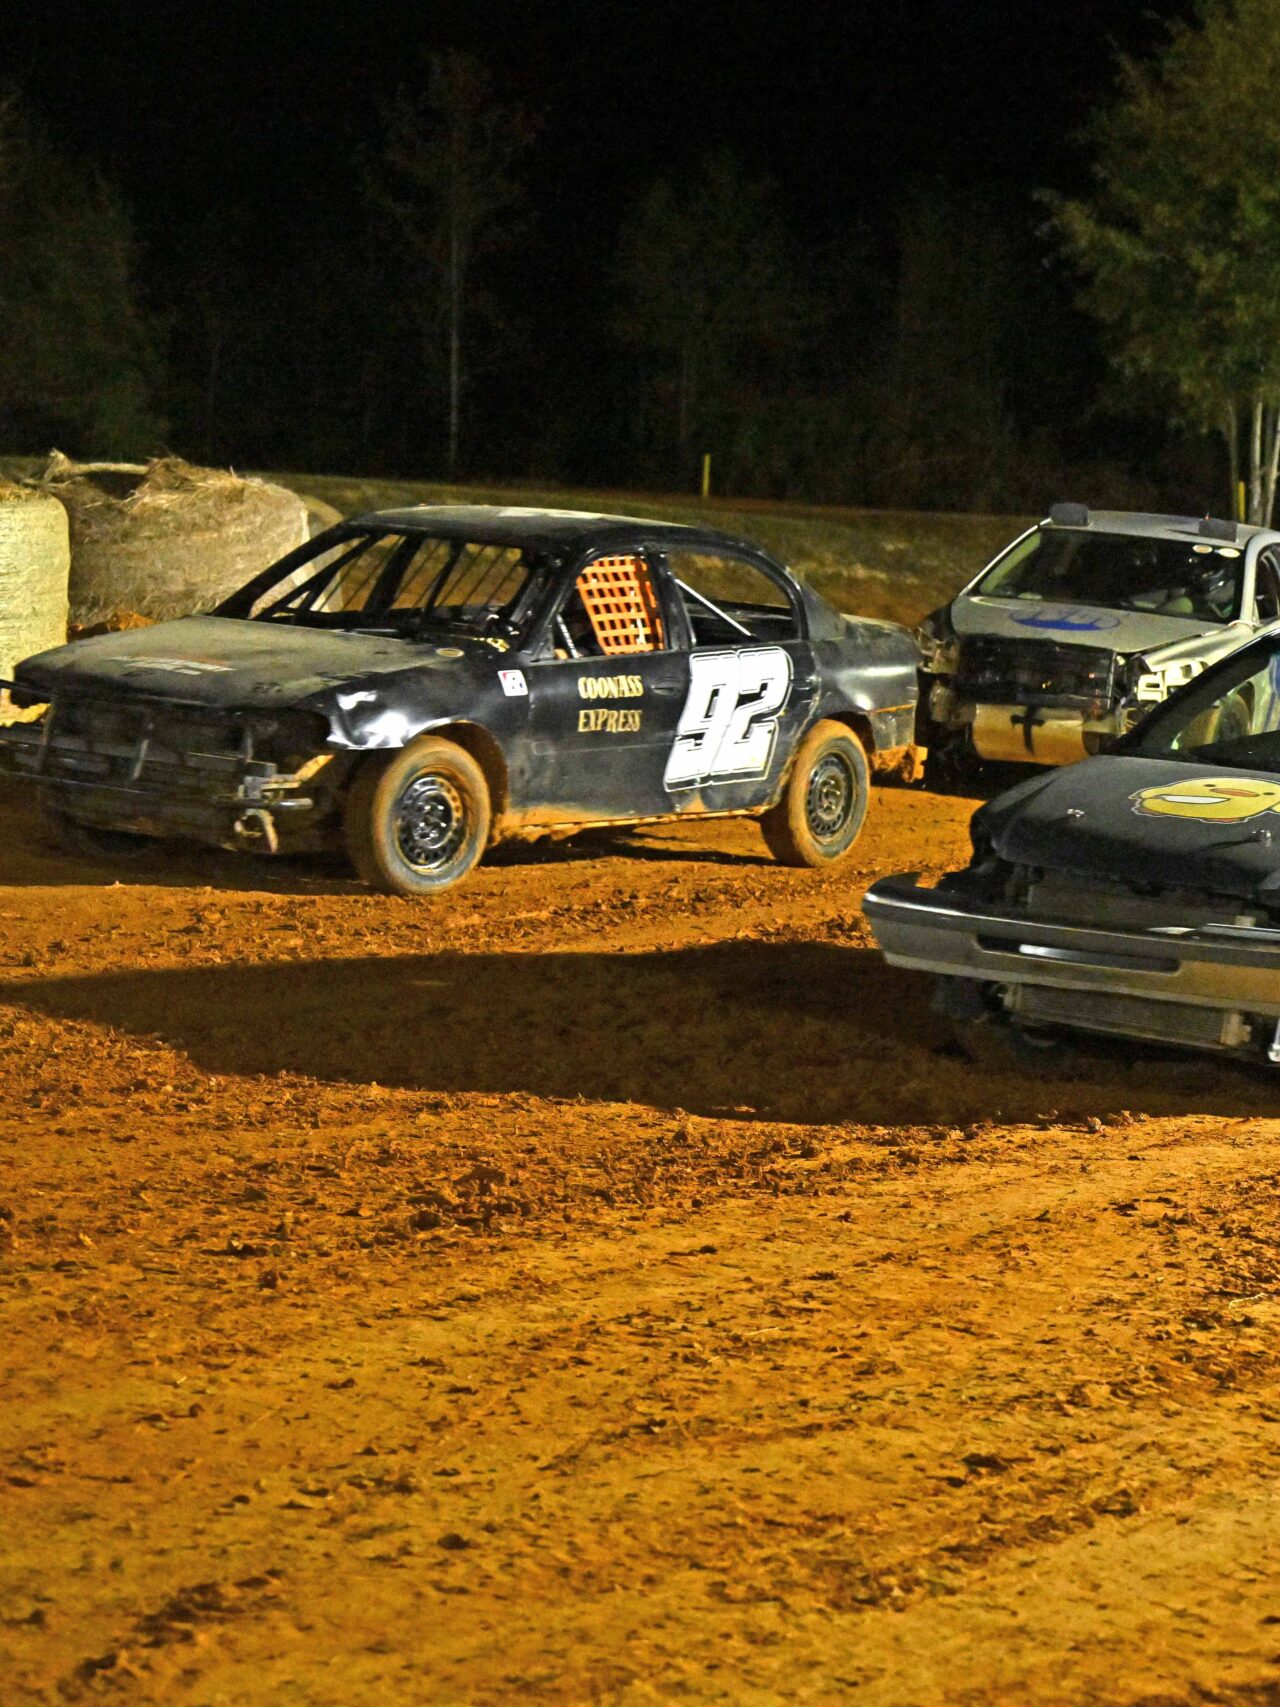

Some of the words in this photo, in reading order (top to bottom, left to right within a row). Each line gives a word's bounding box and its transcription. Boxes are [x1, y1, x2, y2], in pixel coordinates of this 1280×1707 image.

[577, 675, 644, 699] COONASS
[577, 708, 643, 733] EXPRESS
[663, 646, 794, 792] 92
